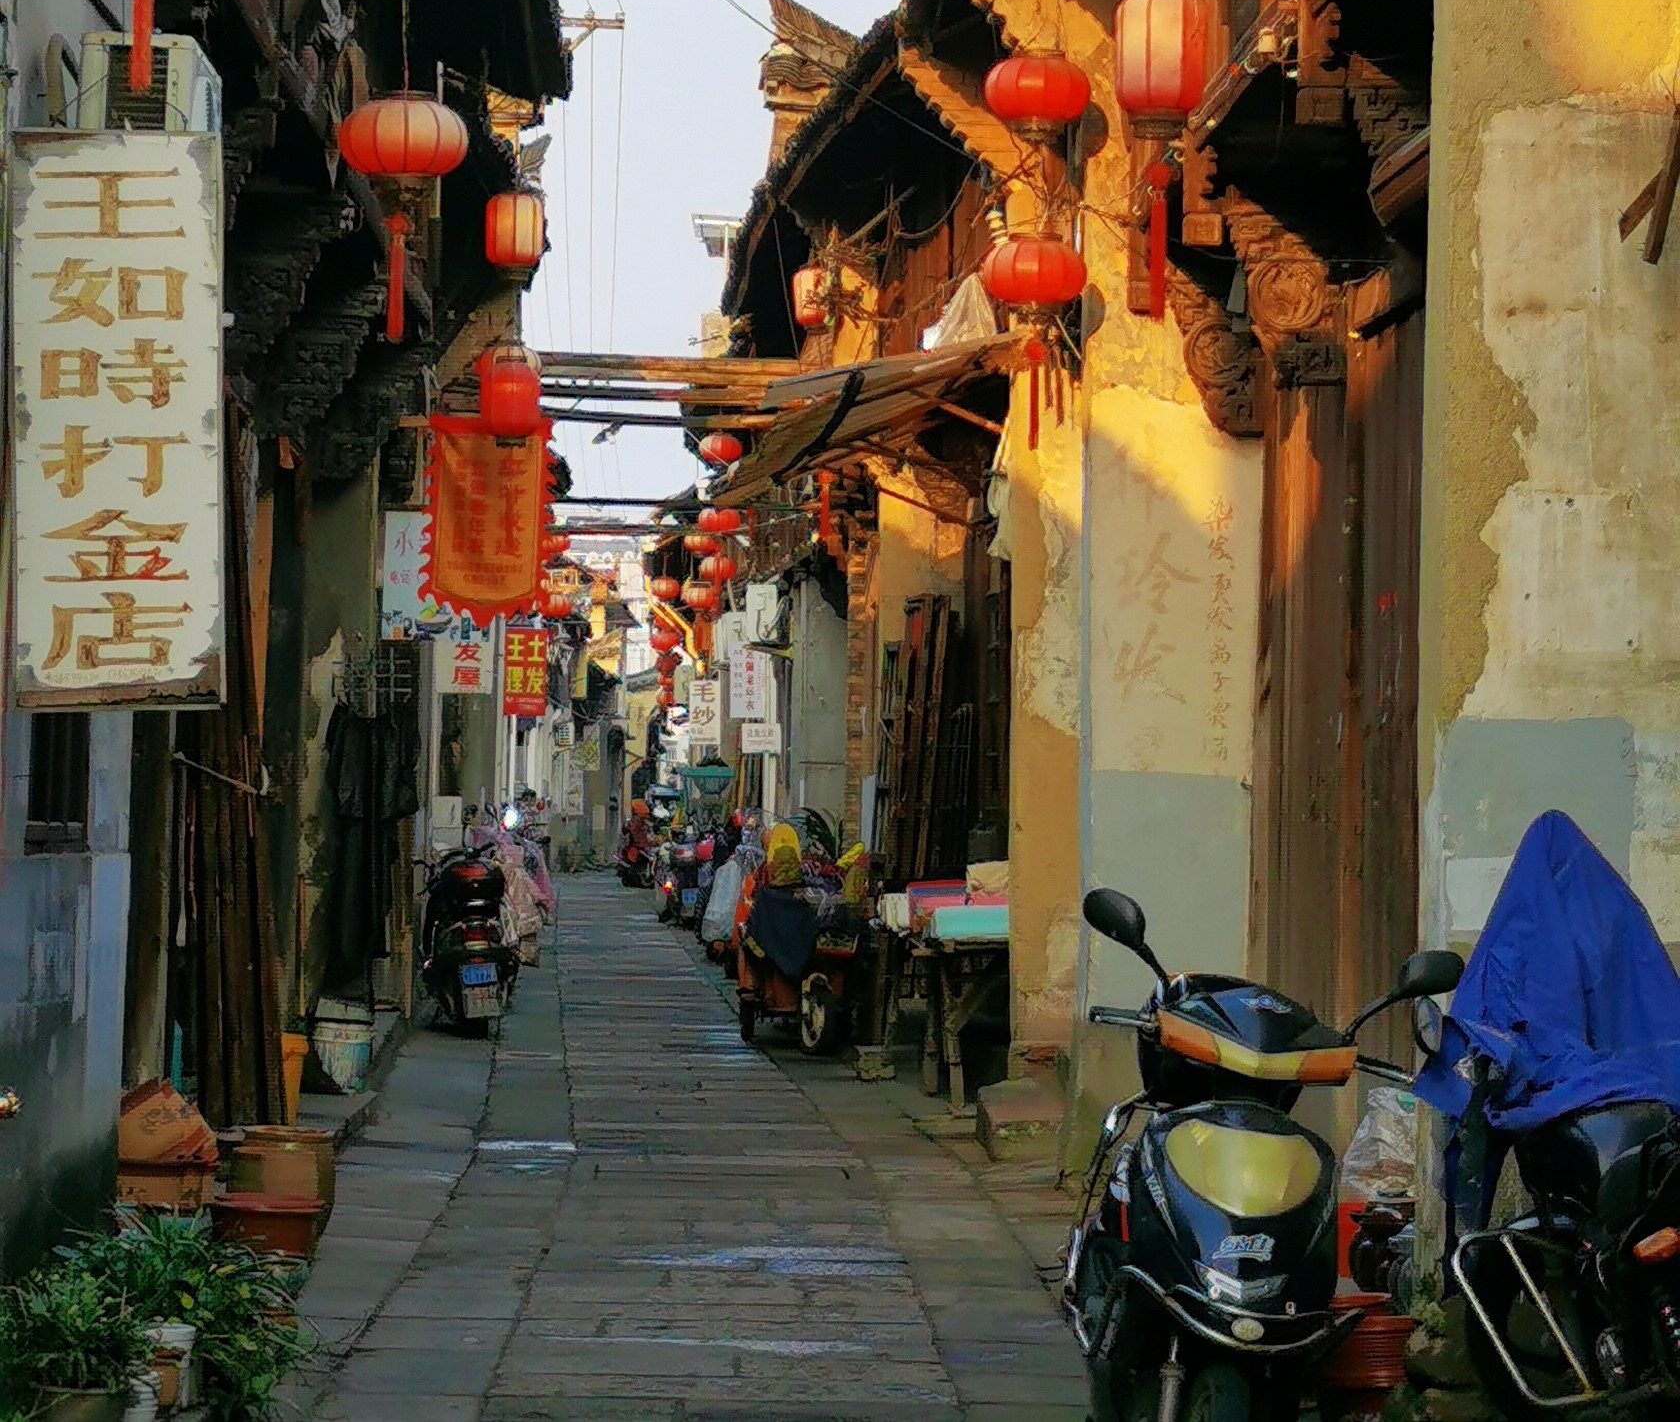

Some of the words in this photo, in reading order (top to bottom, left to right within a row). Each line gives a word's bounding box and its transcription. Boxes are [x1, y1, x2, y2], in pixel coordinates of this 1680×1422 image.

[32, 166, 190, 671] 王如時打金店
